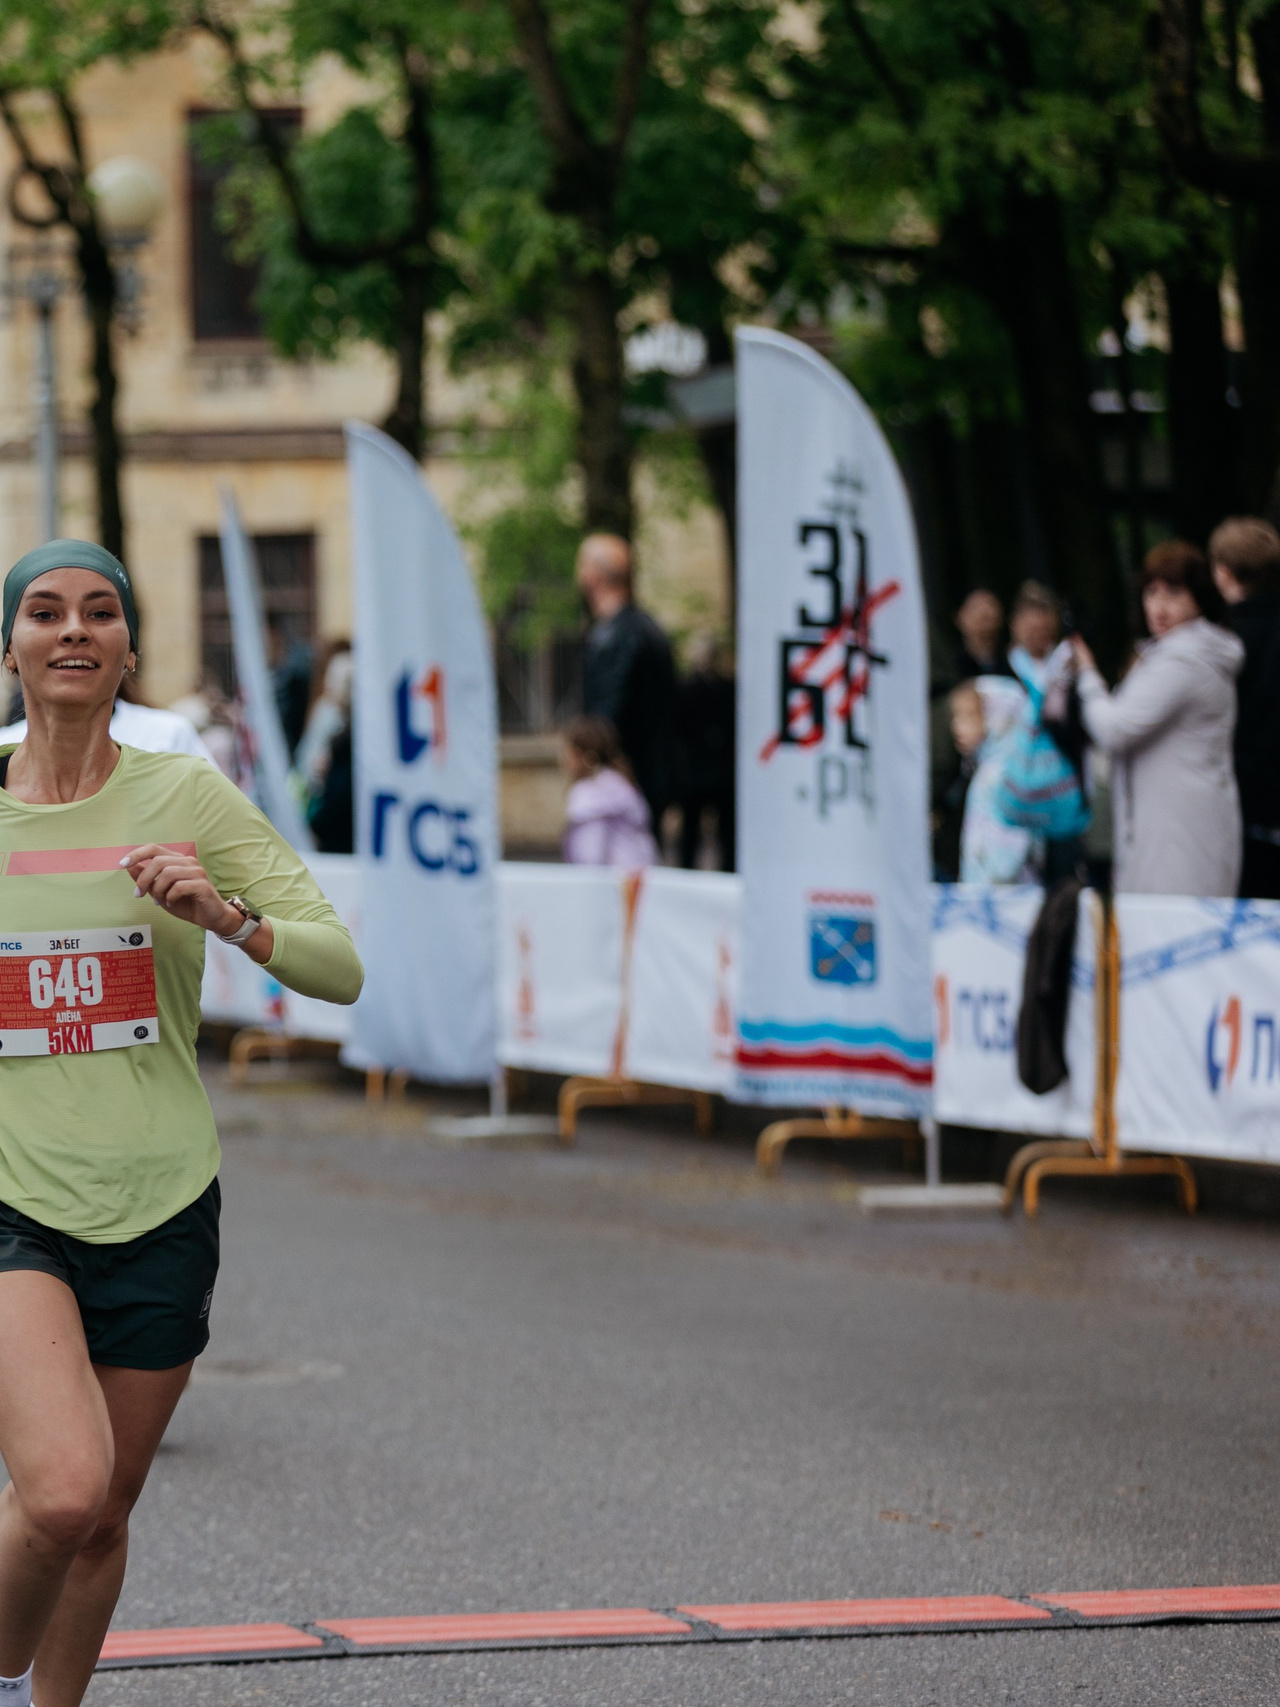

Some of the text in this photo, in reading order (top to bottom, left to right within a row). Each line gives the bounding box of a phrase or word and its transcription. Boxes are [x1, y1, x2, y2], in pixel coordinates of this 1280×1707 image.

[0, 941, 22, 951] ПСБ
[28, 957, 104, 1010] 649
[55, 1010, 82, 1024] АЛЁНА
